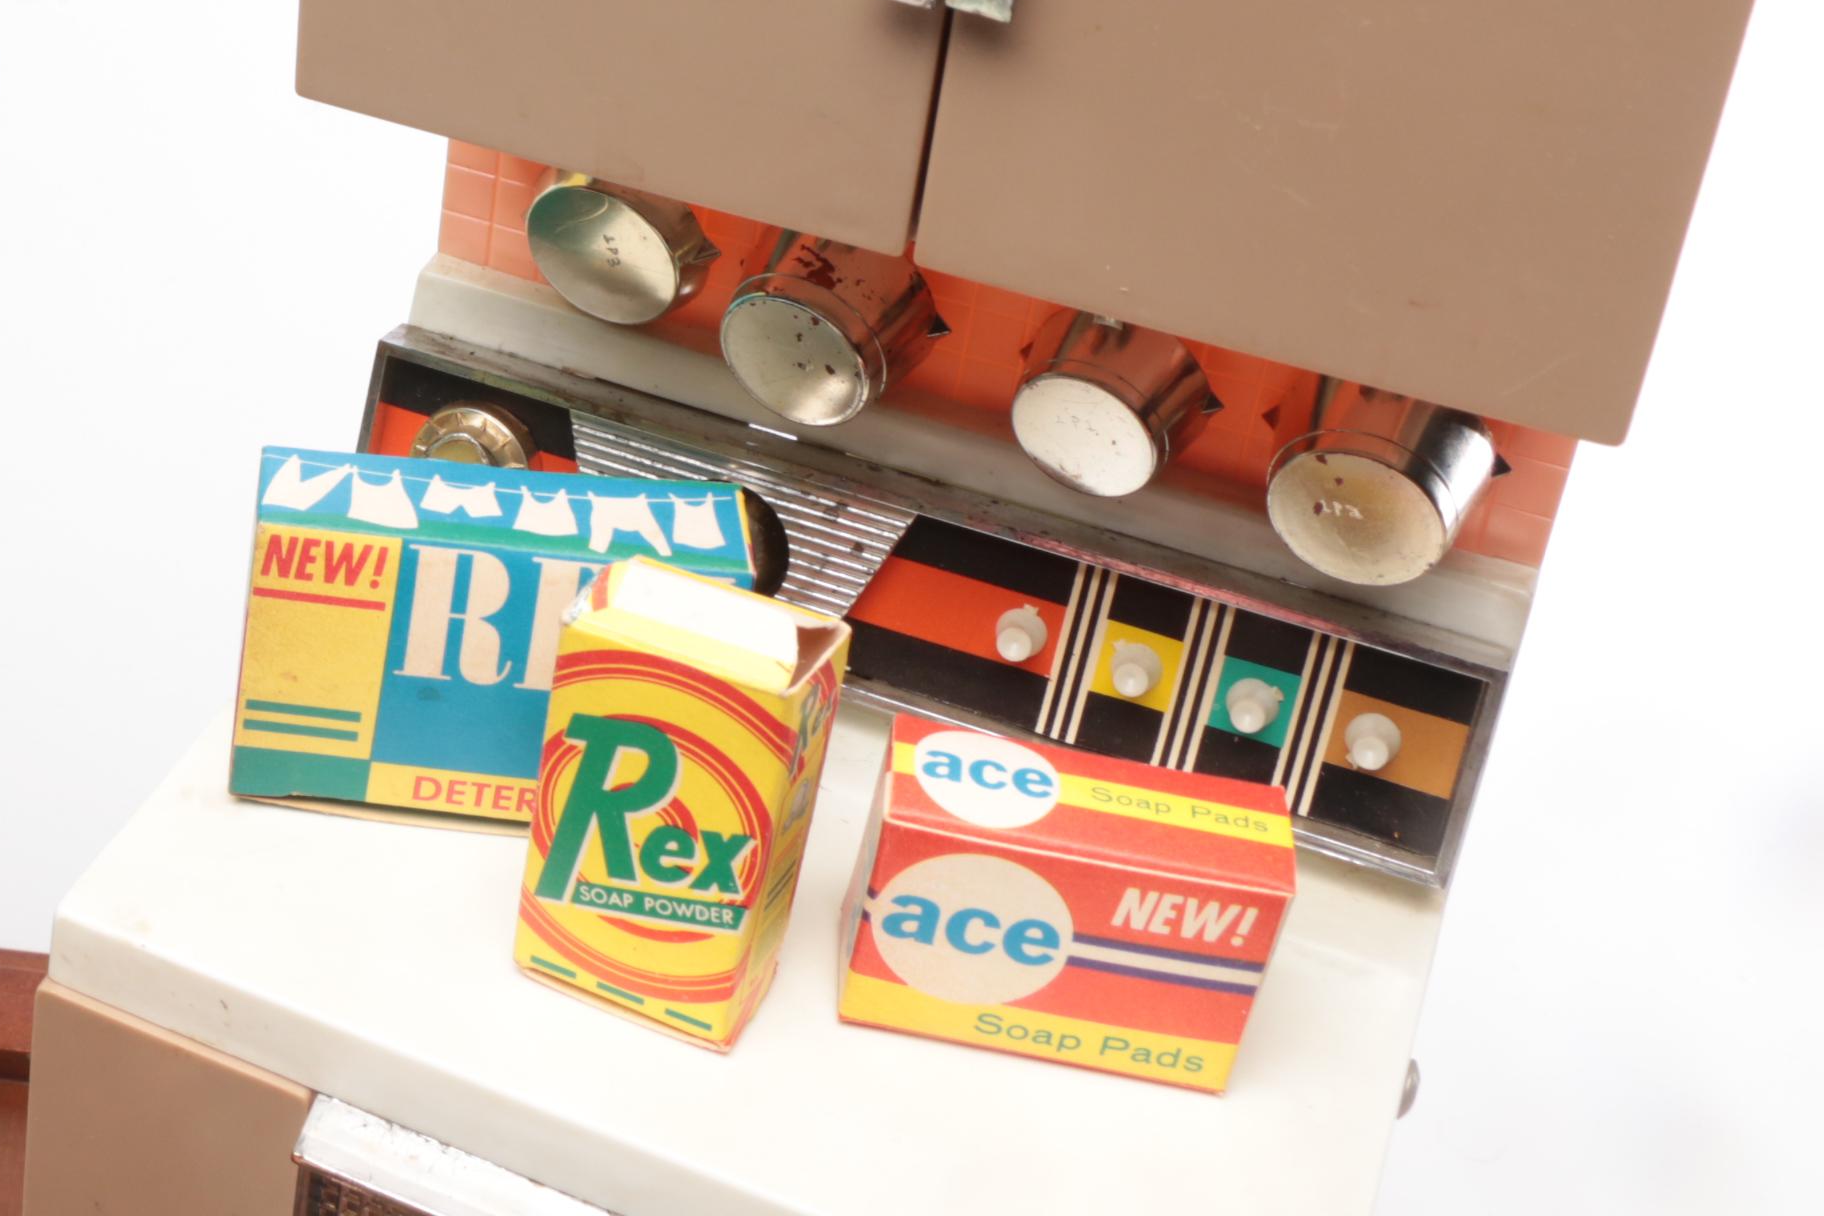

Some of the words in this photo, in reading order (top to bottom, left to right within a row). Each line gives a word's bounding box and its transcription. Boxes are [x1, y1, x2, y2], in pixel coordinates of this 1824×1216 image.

[261, 534, 389, 589] NEW!
[921, 750, 1054, 799] ace
[533, 712, 756, 902] Rex
[1090, 787, 1171, 816] Soap
[1190, 804, 1269, 833] Pads
[579, 884, 634, 910] SOAP
[643, 896, 734, 926] POWDER
[881, 894, 1061, 966] ace
[1111, 887, 1258, 947] NEW!
[973, 1012, 1081, 1052] Soap
[1098, 1035, 1205, 1073] Pads
